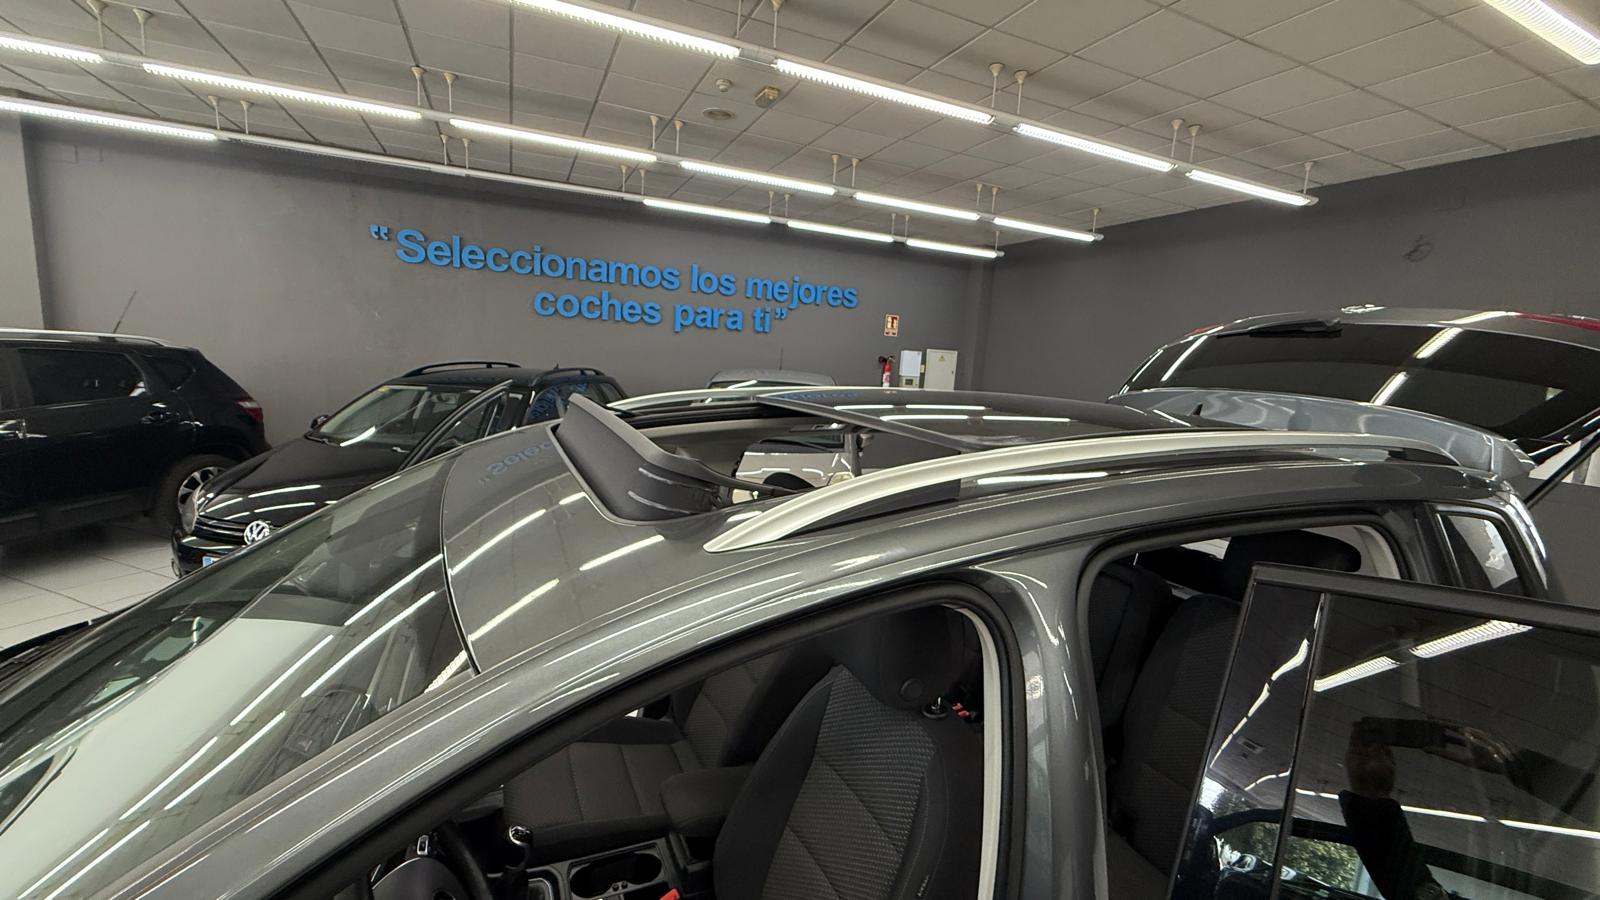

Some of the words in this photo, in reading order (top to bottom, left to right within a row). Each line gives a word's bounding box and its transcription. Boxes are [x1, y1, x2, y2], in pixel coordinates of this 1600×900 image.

[690, 264, 736, 297] los
[745, 276, 859, 310] mejores
[533, 291, 662, 325] coches
[673, 303, 743, 333] para
